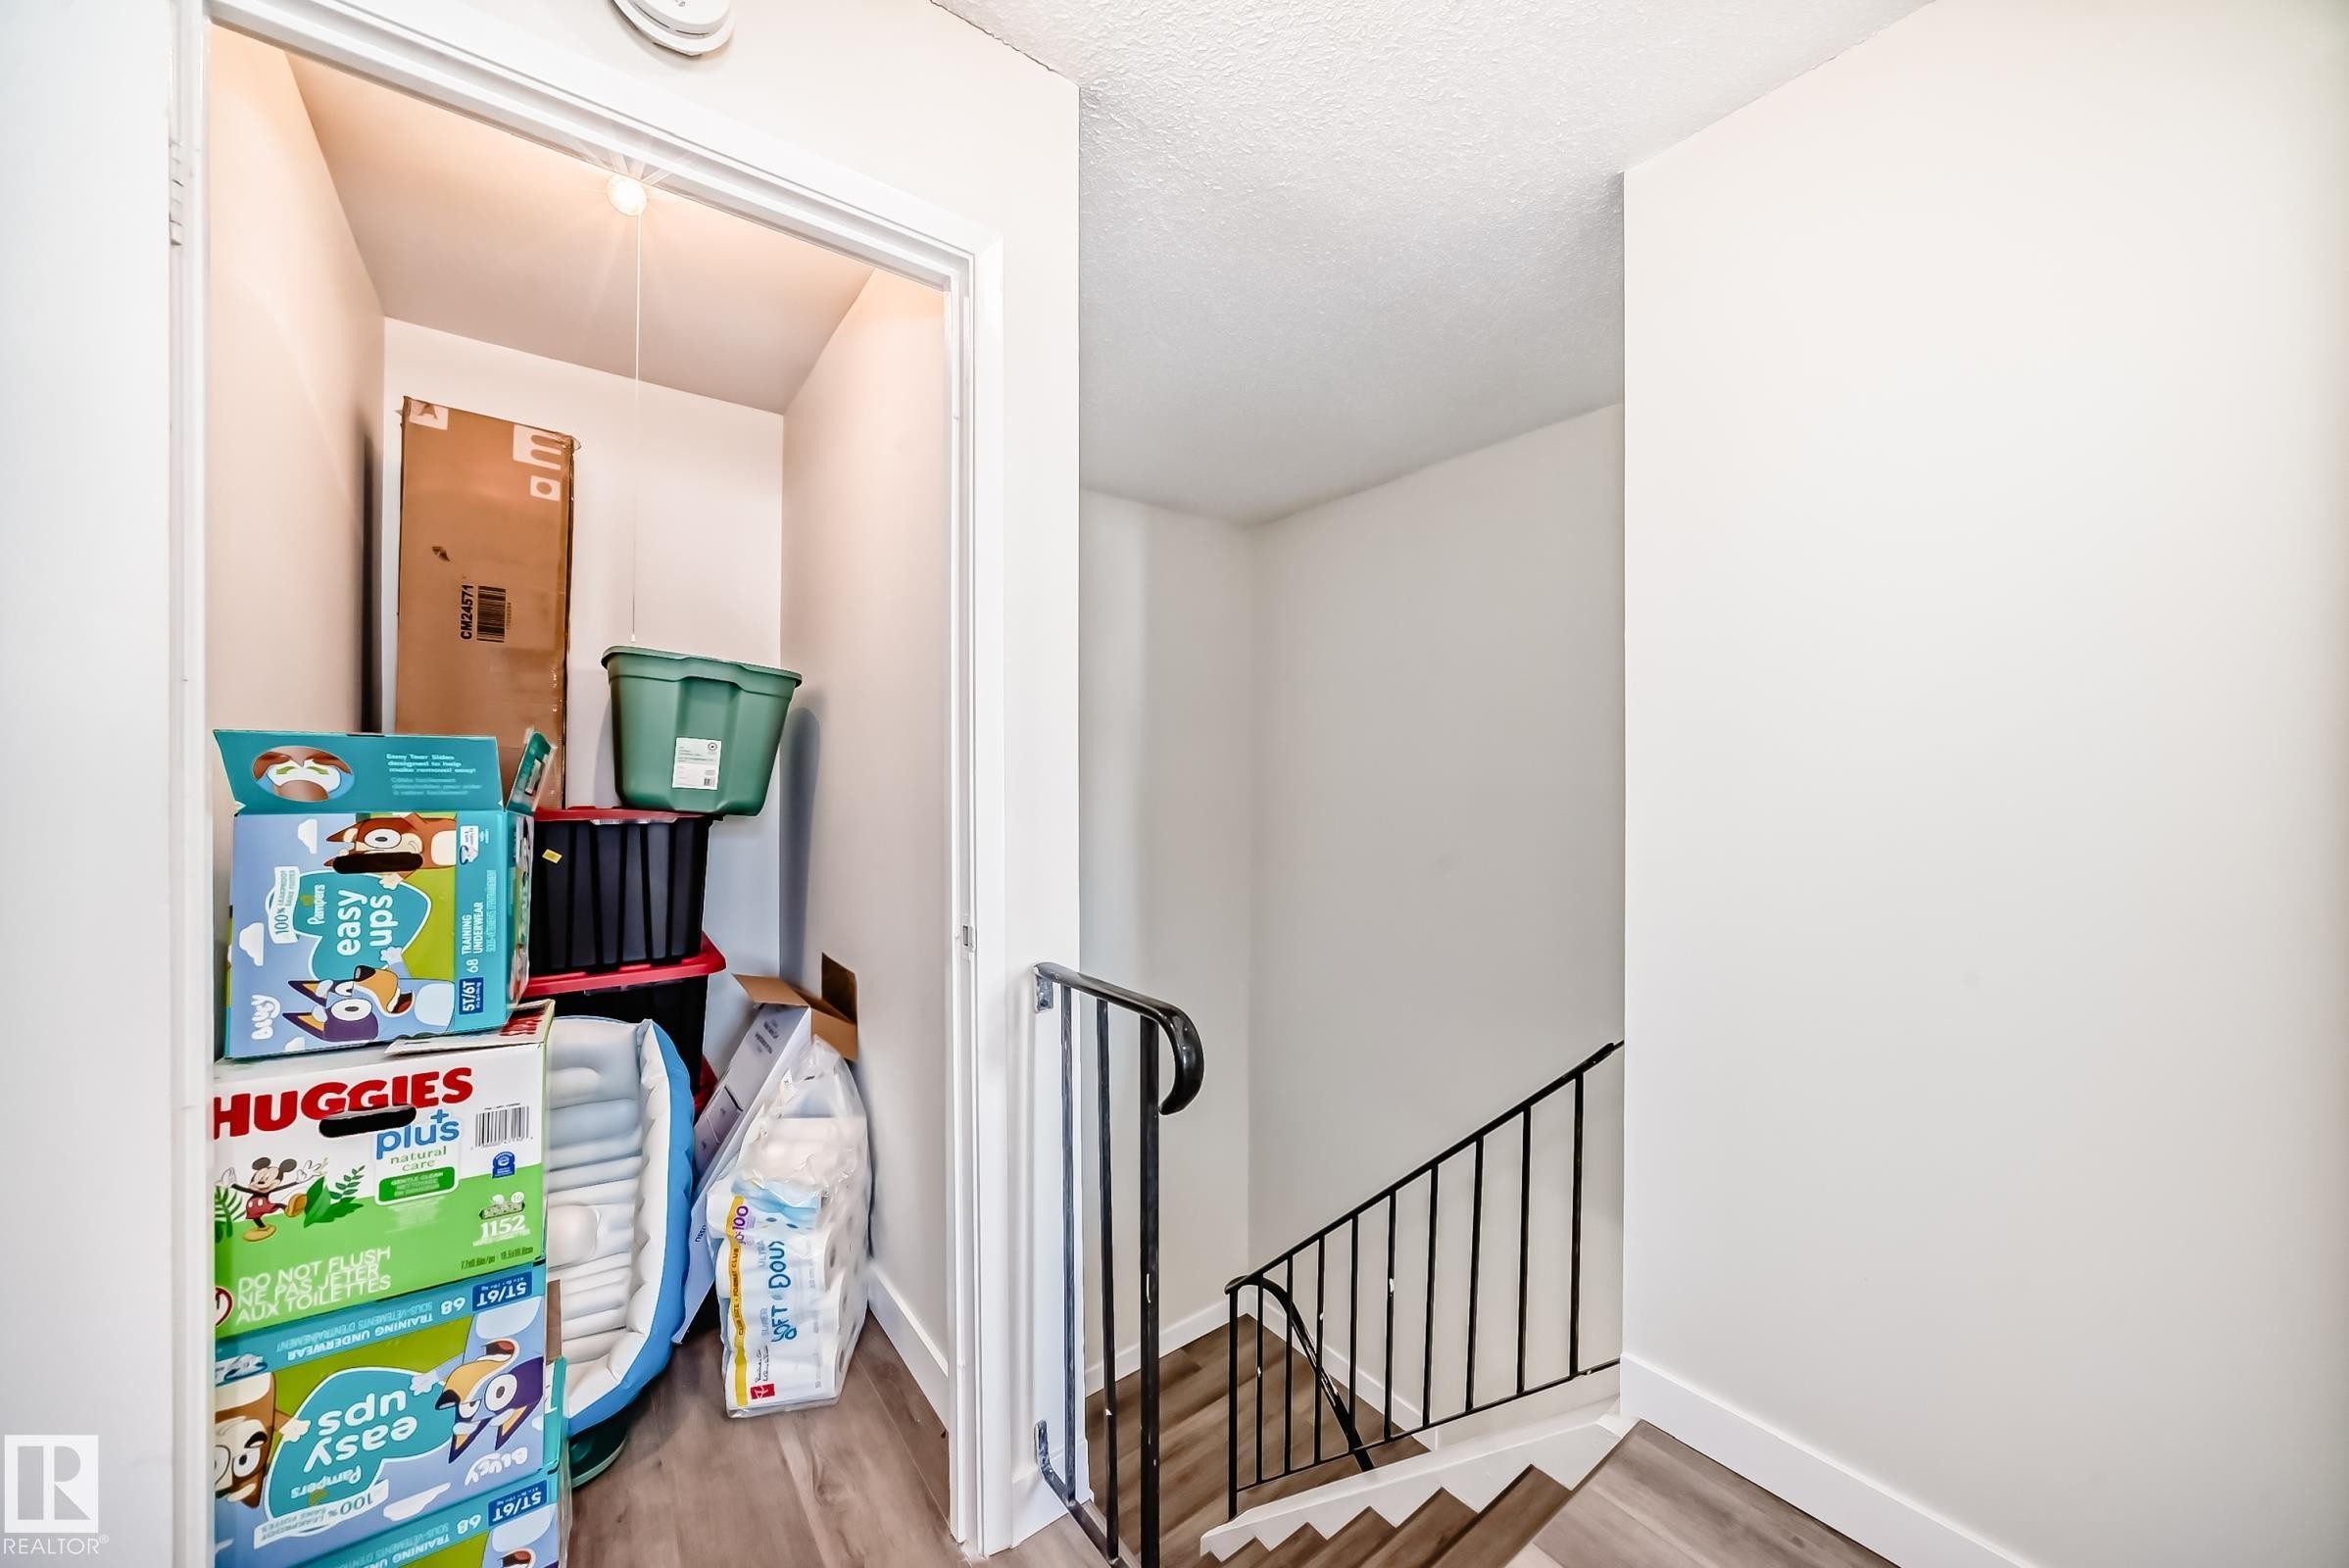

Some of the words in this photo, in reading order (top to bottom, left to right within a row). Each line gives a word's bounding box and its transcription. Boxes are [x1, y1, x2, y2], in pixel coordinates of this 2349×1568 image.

[460, 584, 474, 640] CM24571
[307, 884, 325, 924] Pampers
[336, 889, 367, 956] easy
[368, 894, 399, 947] ups
[462, 913, 472, 956] TRAINING
[472, 901, 484, 955] UNDERWEAR
[466, 958, 478, 973] 68
[463, 980, 475, 1012] 5T/6T
[214, 1067, 473, 1141] HUGGIES
[376, 1117, 460, 1160] plus
[390, 1145, 447, 1165] natural
[402, 1159, 435, 1172] care
[480, 1214, 526, 1240] 1152
[238, 1272, 271, 1295] DO
[278, 1260, 322, 1285] NOT
[328, 1246, 391, 1273] FLUSH
[731, 1248, 740, 1271] CLUB
[235, 1302, 280, 1326] AUX
[286, 1274, 391, 1312] TOILETTES
[237, 1288, 268, 1310] NE
[274, 1278, 313, 1301] PAS
[318, 1262, 379, 1291] JETER
[476, 1282, 527, 1307] 5T/6T
[440, 1297, 466, 1315] 68
[374, 1312, 433, 1337] TRAINING
[287, 1329, 370, 1361] UNDERWEAR
[318, 1389, 407, 1436] ups
[303, 1416, 417, 1473] easy
[290, 1465, 363, 1498] Pampers
[326, 1496, 373, 1517] 100%
[492, 1491, 542, 1522] 5T/6T
[456, 1514, 482, 1535] 68
[392, 1534, 451, 1563] TRAINING
